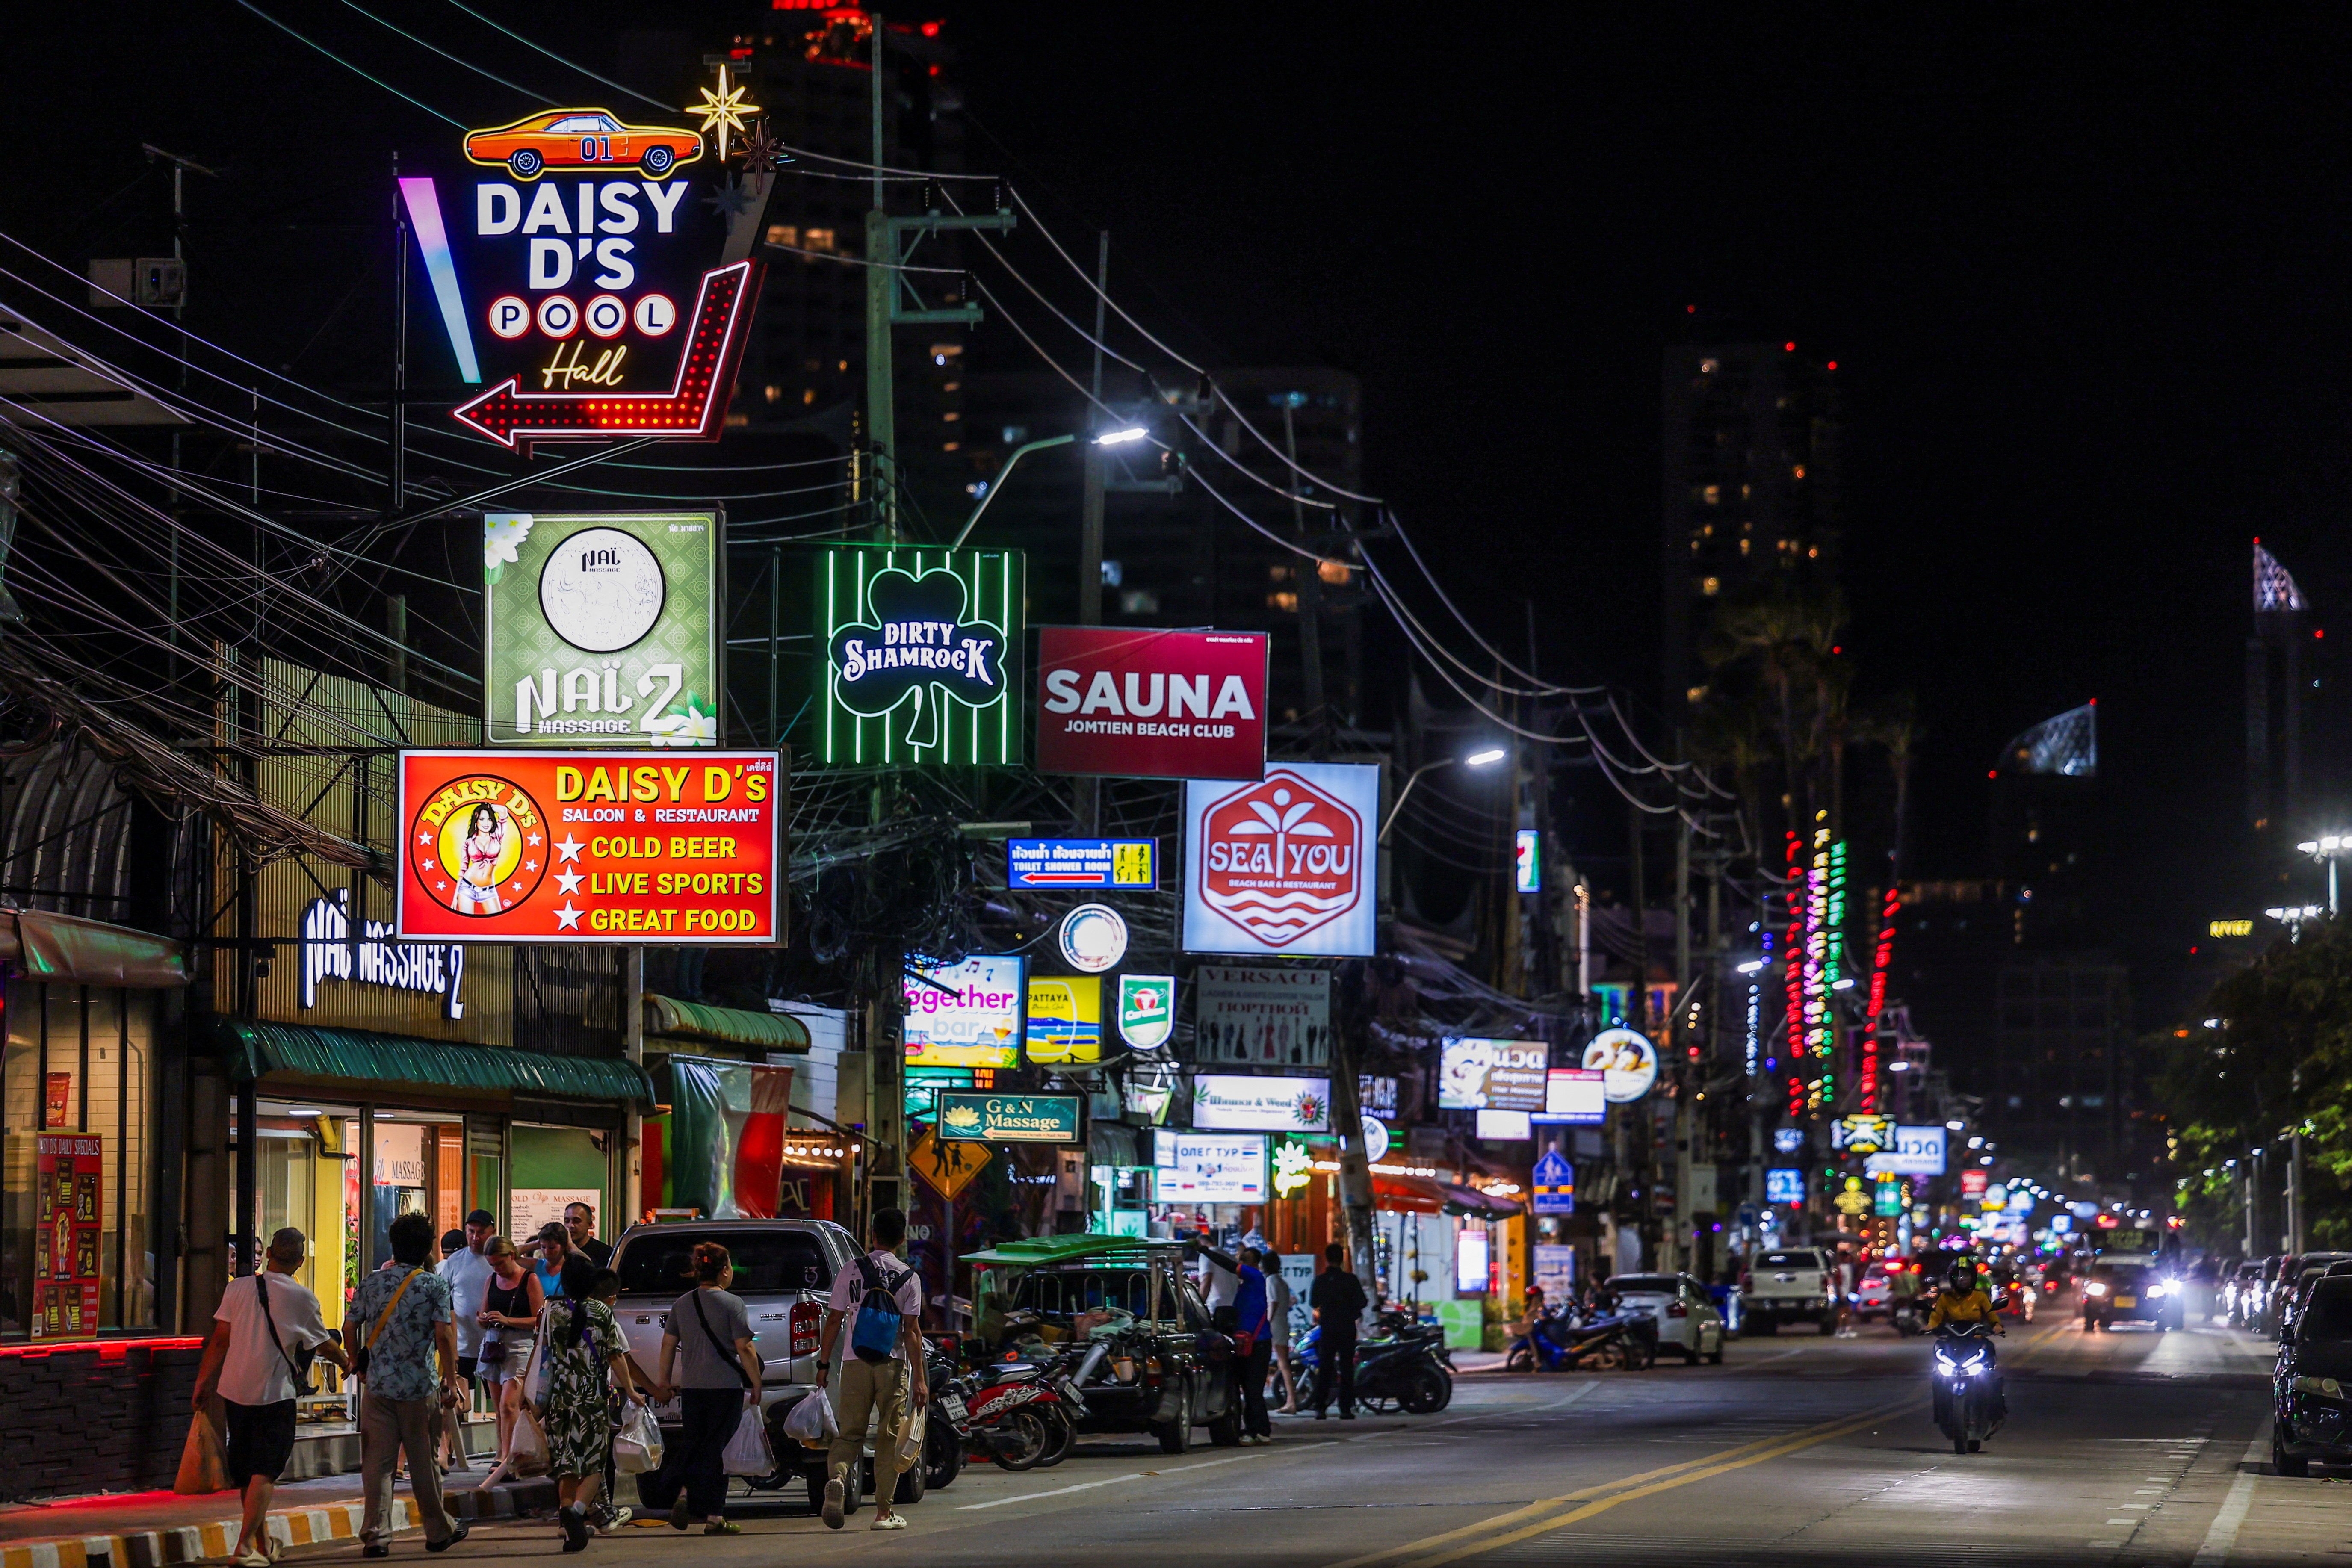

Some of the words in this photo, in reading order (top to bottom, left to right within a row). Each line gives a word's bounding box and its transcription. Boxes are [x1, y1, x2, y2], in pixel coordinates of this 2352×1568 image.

[581, 136, 613, 161] 01
[477, 181, 689, 235] DAISY
[529, 238, 635, 290] D'S
[497, 301, 667, 334] POOL
[542, 340, 626, 389] Hall
[884, 622, 954, 646] DIRTY
[843, 638, 993, 685] SHAMROCK
[637, 664, 683, 732] 2
[1044, 669, 1255, 720] SAUNA
[538, 720, 631, 734] MASSAGE
[1064, 720, 1132, 735] JOMTIEN
[1137, 722, 1189, 737] BEACH
[1193, 725, 1235, 738] CLUB
[556, 766, 690, 803] DAISY
[421, 780, 506, 827] DAISY
[562, 808, 625, 823] SALOON
[634, 809, 646, 823] &
[655, 809, 759, 823] RESTAURANT
[591, 836, 662, 859] COLD
[670, 837, 737, 859] BEER
[1209, 842, 1275, 873] SEA
[1288, 843, 1351, 876] YOU
[1013, 862, 1042, 871] TOILET
[1044, 862, 1082, 871] SHOWER
[1084, 862, 1111, 871] ROOM
[591, 873, 650, 895] LIVE
[656, 873, 763, 895] SPORTS
[1228, 879, 1256, 887] BEACH
[1258, 880, 1275, 888] BAR
[1283, 880, 1337, 890] RESTAURANT
[591, 909, 677, 932] GREAT
[685, 909, 756, 931] FOOD
[903, 983, 1014, 1013] ogether
[933, 1017, 979, 1036] bar
[986, 1099, 1002, 1113] G
[1005, 1103, 1015, 1113] &
[1255, 1098, 1262, 1106] &
[1265, 1098, 1292, 1107] Weed
[985, 1113, 1060, 1131] Massage
[74, 1139, 99, 1155] SPECIALS
[1181, 1148, 1211, 1156] ОЛЕГ
[1216, 1148, 1238, 1156] ТУР
[392, 1160, 425, 1180] MASSAGE
[1292, 1267, 1312, 1277] ТУР
